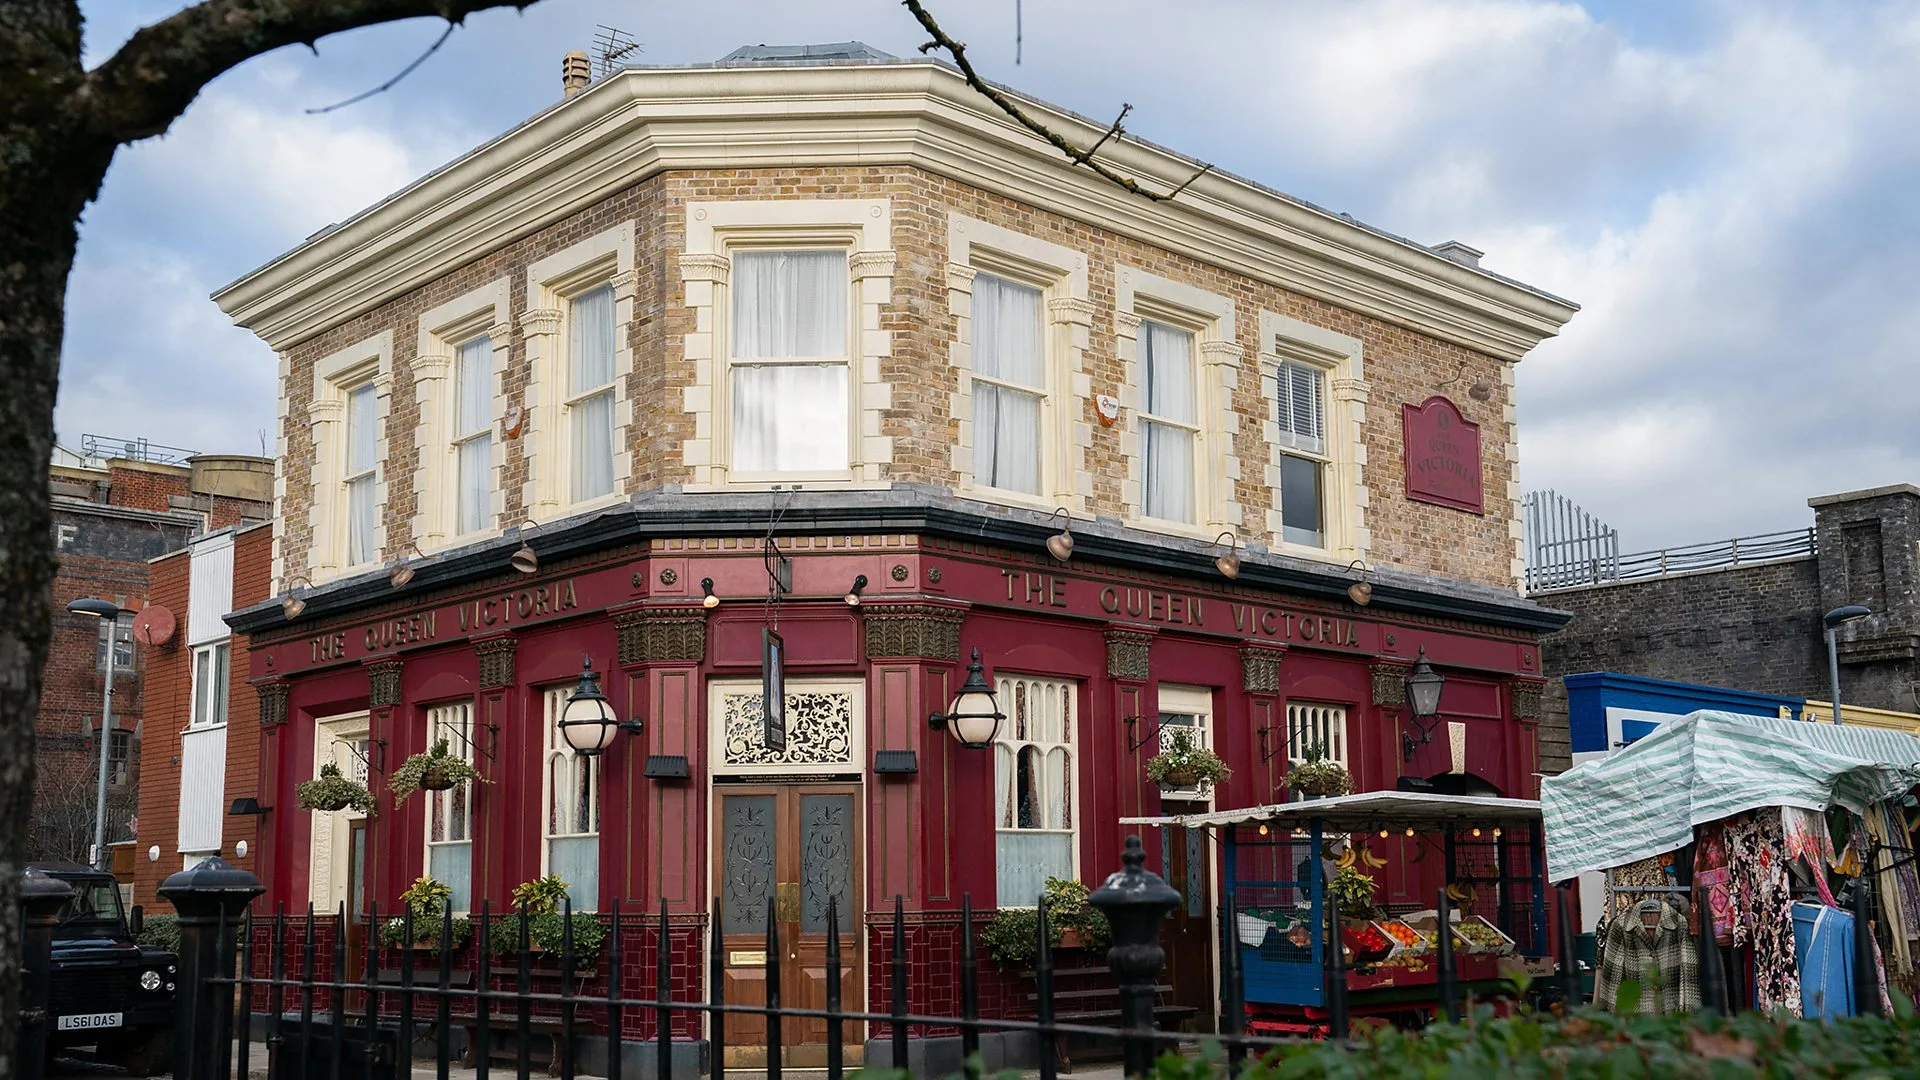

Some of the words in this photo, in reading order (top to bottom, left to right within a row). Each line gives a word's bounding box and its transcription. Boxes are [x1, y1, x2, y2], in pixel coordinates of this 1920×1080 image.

[1429, 438, 1460, 455] QUEEN
[1416, 455, 1475, 488] VICTORIA
[309, 631, 347, 663] THE
[364, 610, 437, 651] QUEEN
[458, 579, 578, 632] VICTORIA
[1000, 568, 1067, 608] THE
[1100, 585, 1203, 627] QUEEN
[1231, 602, 1360, 647] VICTORIA
[65, 1016, 91, 1028] LS61
[93, 1014, 116, 1027] OAS
